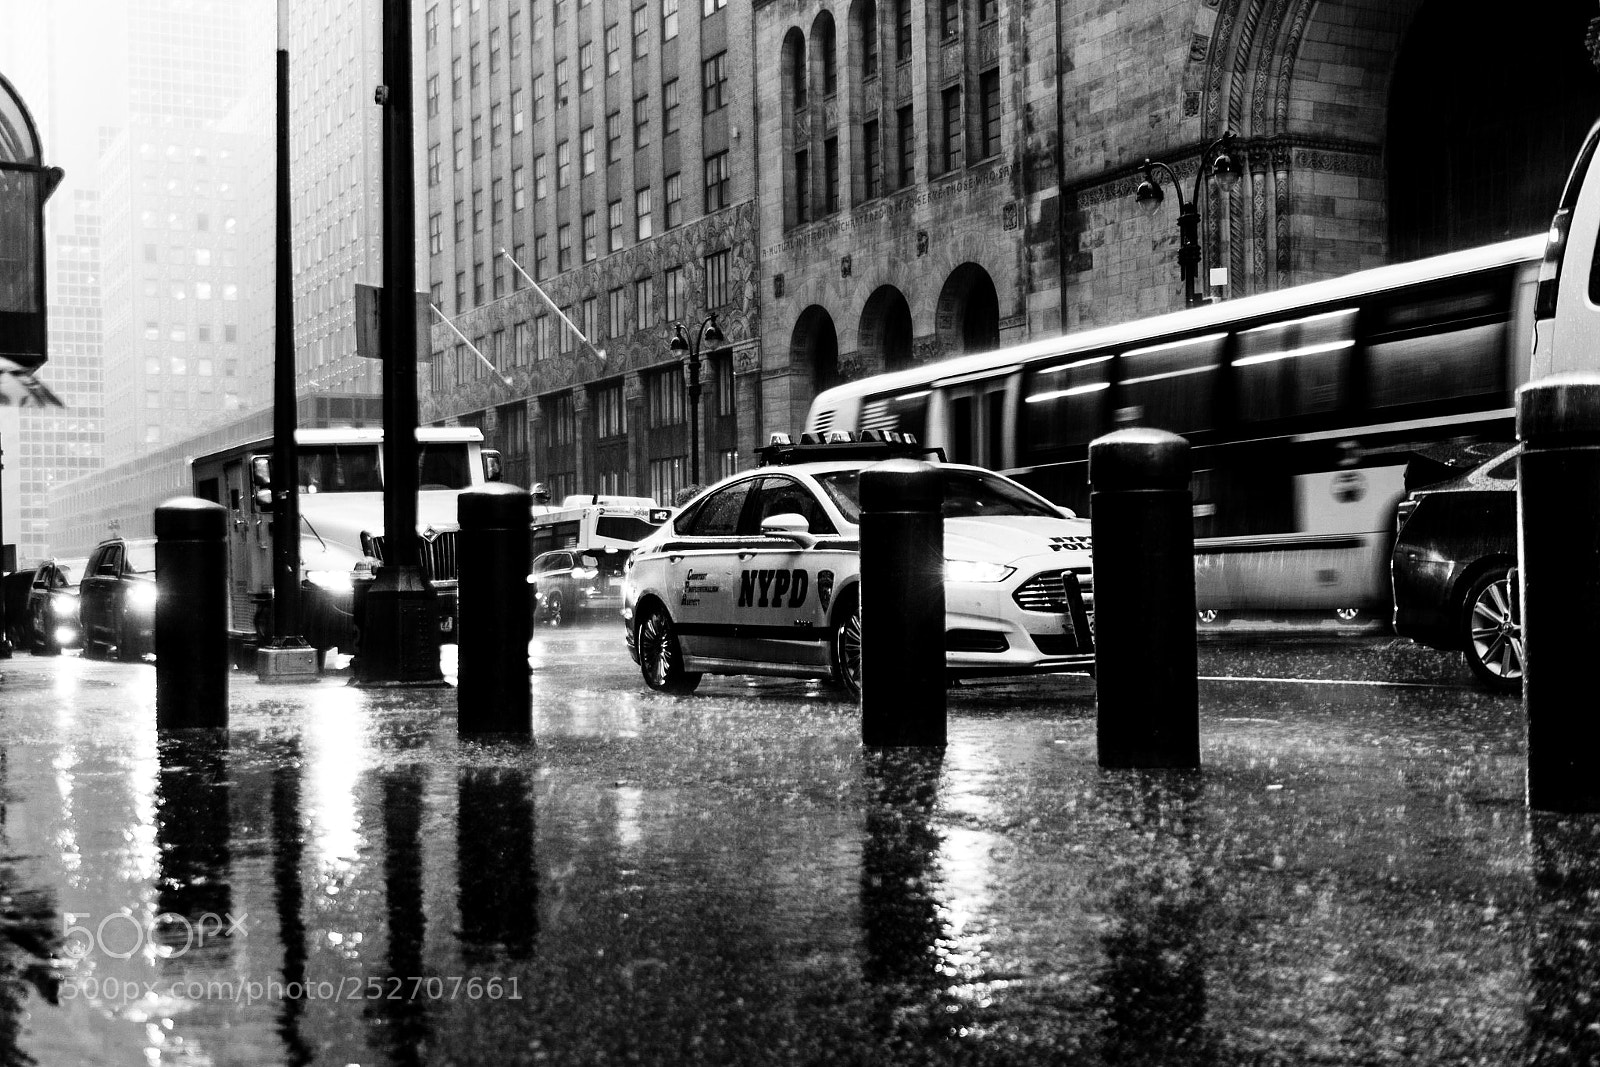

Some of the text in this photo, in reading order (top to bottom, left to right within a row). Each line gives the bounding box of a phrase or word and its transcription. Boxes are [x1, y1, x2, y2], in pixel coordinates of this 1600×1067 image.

[945, 178, 973, 197] THOSE
[974, 170, 996, 187] WHO
[1048, 543, 1092, 551] POL
[738, 569, 808, 608] NYPD
